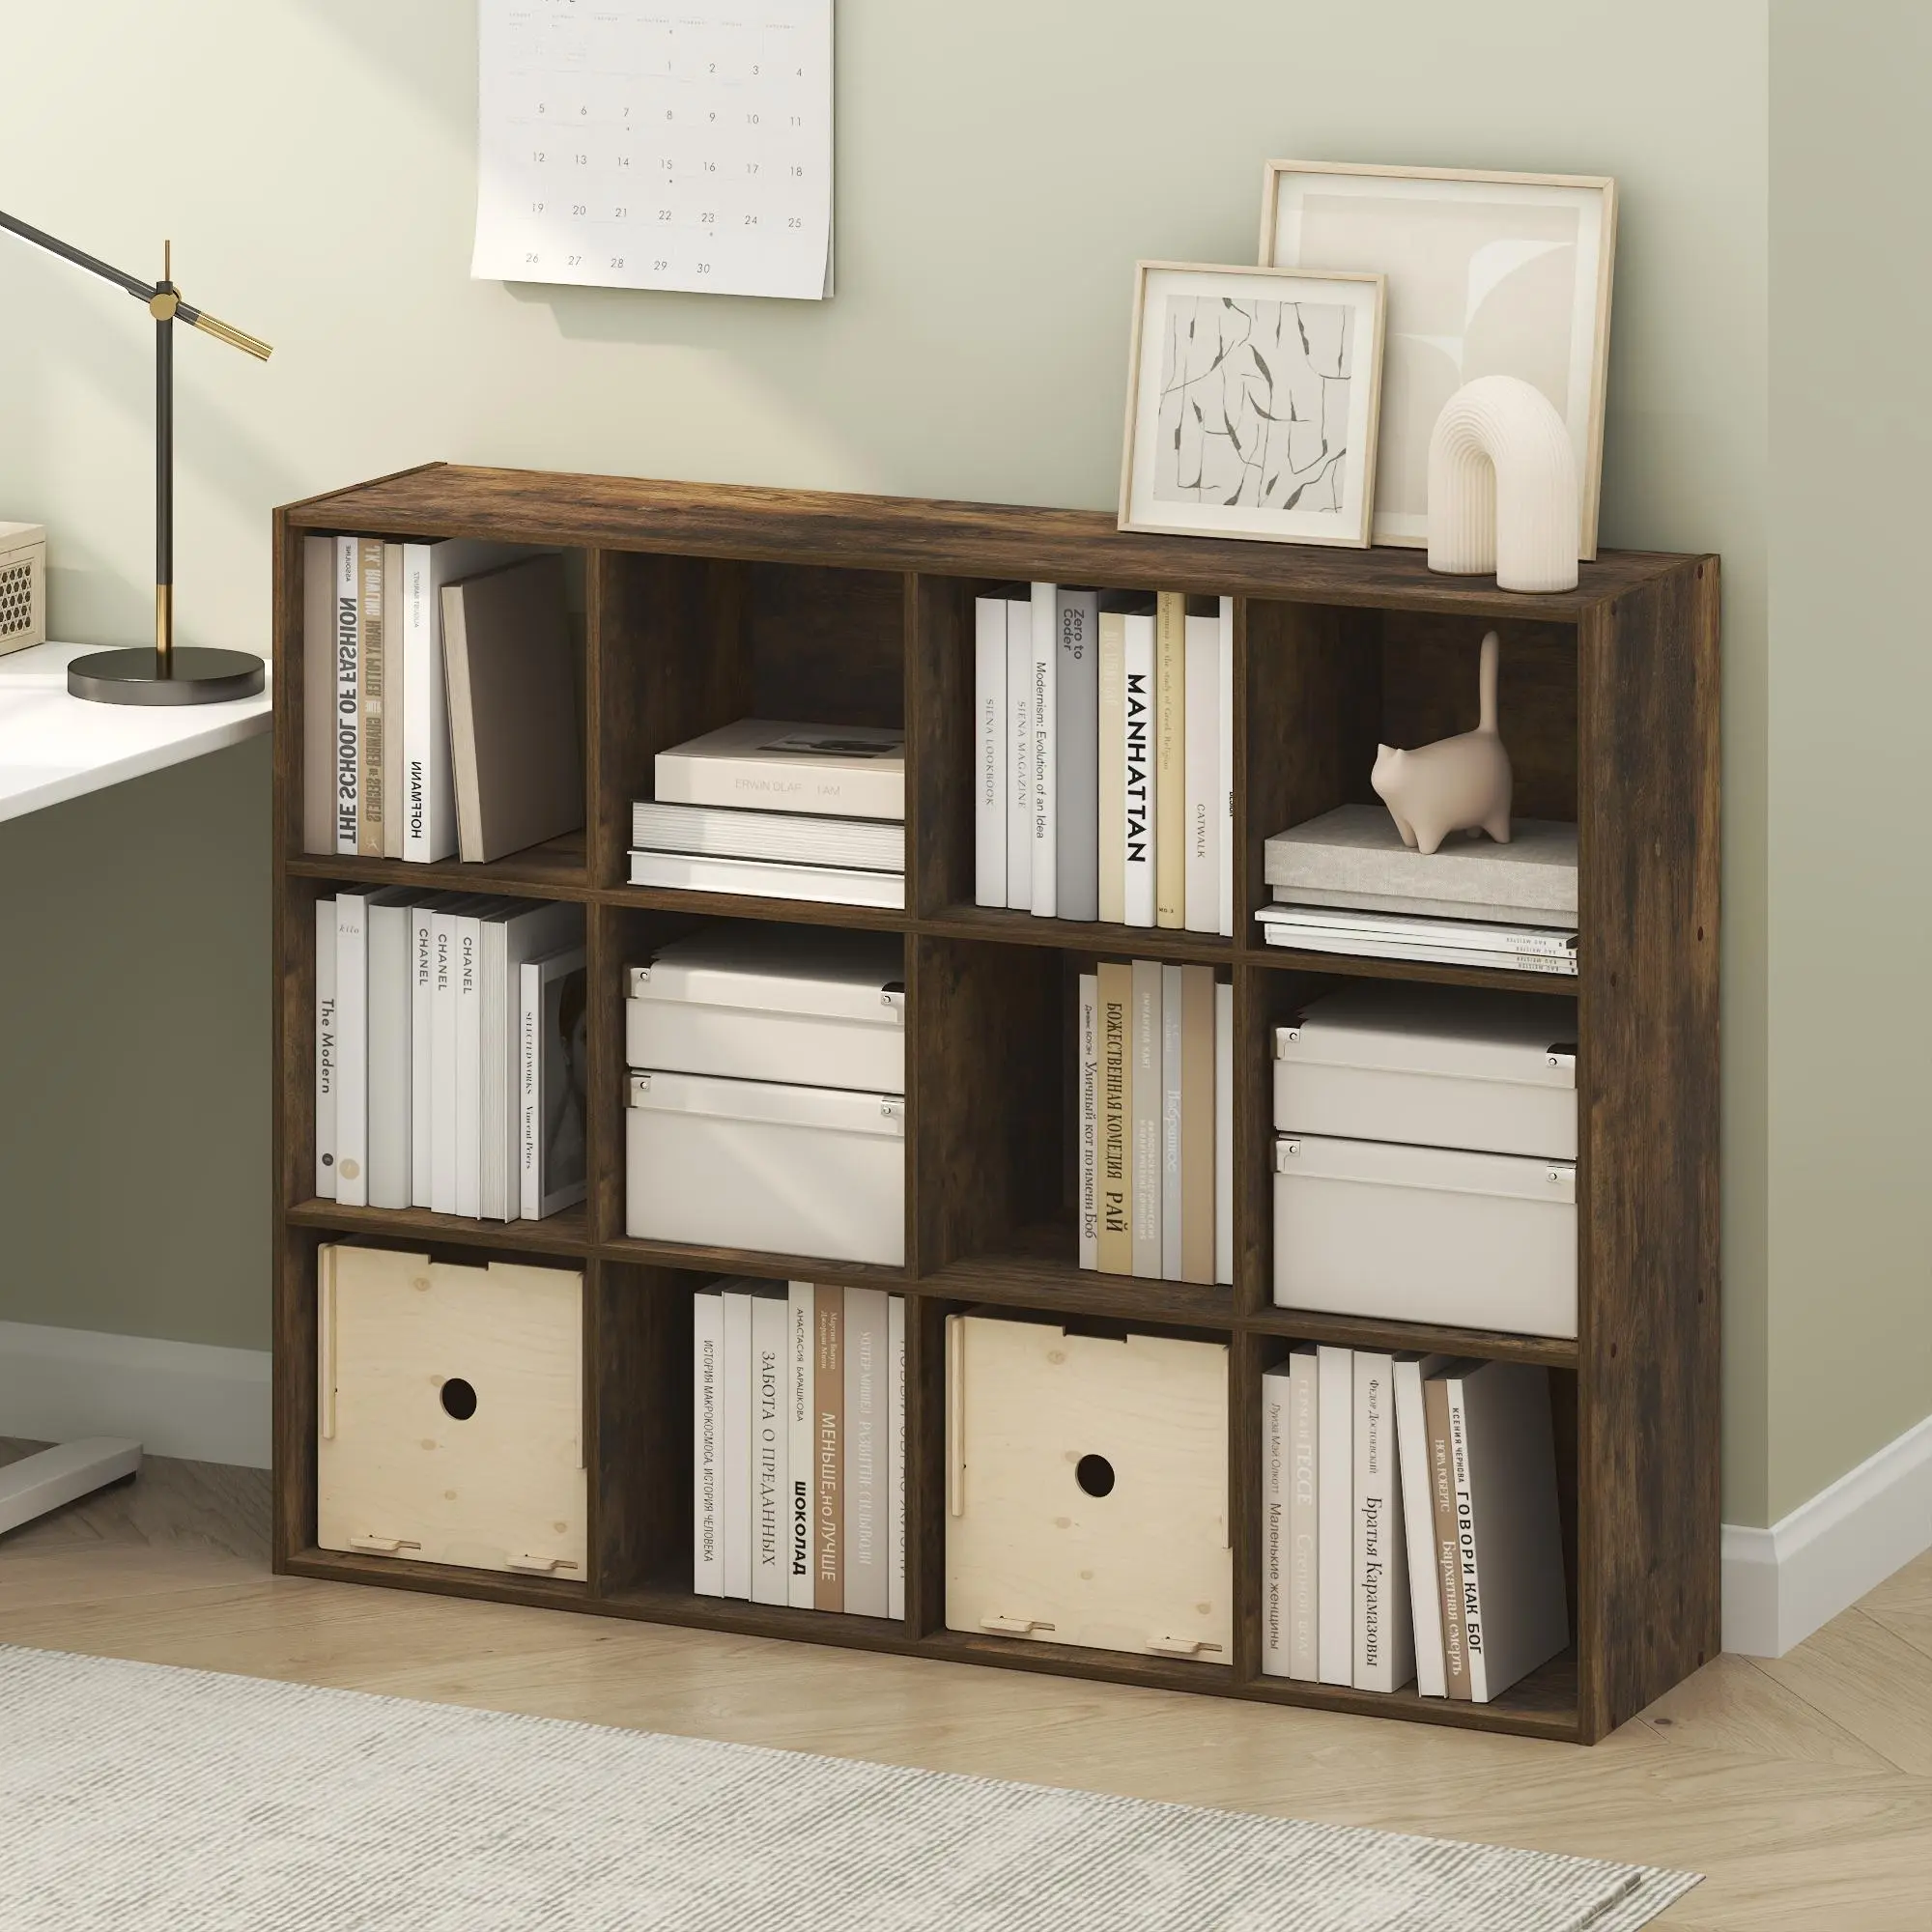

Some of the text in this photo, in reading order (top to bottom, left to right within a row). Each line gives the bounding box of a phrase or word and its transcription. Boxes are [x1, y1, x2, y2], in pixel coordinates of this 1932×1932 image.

[668, 60, 802, 77] 1 2 3 4
[539, 102, 801, 127] 5 6 7 8 9 10 11
[533, 152, 803, 177] 12 13 14 15 16 17 18
[532, 203, 802, 228] 19 20 21 22 23 24 25
[526, 253, 710, 274] 26 27 28 29 30
[1063, 609, 1073, 651] Coder
[1073, 609, 1085, 660] Zero to
[1162, 593, 1173, 639] rolegomena
[1163, 671, 1173, 692] study
[1164, 655, 1173, 668] the
[1163, 708, 1173, 731] Greek
[1164, 696, 1173, 705] of
[985, 738, 994, 806] LOOKBOOK
[1017, 742, 1026, 809] MAGAZINE
[1036, 661, 1047, 839] Modernism: Evolution of an Idea
[1127, 674, 1147, 863] MANHATTAN
[1162, 736, 1173, 770] Religion
[735, 779, 770, 792] ERWIN
[773, 781, 802, 793] OLAF
[823, 786, 840, 797] AM
[1197, 804, 1206, 859] CATWALK
[419, 928, 429, 986] CHANEL
[438, 933, 447, 991] CHANEL
[463, 936, 472, 995] CHANEL
[322, 999, 334, 1094] The Modern
[526, 1105, 534, 1139] Vincent
[1105, 1002, 1128, 1233] БОЖЕСТВЕННАЯ КОМЕДИЯ РАЙ
[526, 1142, 534, 1170] Peters
[1084, 1061, 1097, 1239] Уличный кот по имени Боб
[796, 1308, 805, 1422] АНАСТАСИЯ БАРАШКОВА
[702, 1340, 714, 1562] ИСТОРИЯ МАКРОКОСМОСА, ИСТОРИЯ ЧЕЛОВЕКА
[759, 1350, 776, 1566] ЗАБОТА О ПРЕДАННЫХ
[819, 1412, 836, 1495] МЕНЬШЕ,
[1270, 1403, 1282, 1494] Луиза Мэй Олкотт
[1295, 1442, 1313, 1507] ГЕССЕ
[1452, 1406, 1464, 1483] КСЕНИЯ ЧЕРНОВА
[793, 1480, 807, 1576] ШОКОЛАД
[820, 1519, 836, 1582] ЛУЧШЕ
[1267, 1502, 1282, 1650] Маленькие женщины
[1361, 1496, 1382, 1667] Братья Карамазовы
[1457, 1491, 1482, 1655] ГОВОРИ КАК БОГ
[1439, 1540, 1463, 1676] Бархатная смерть
